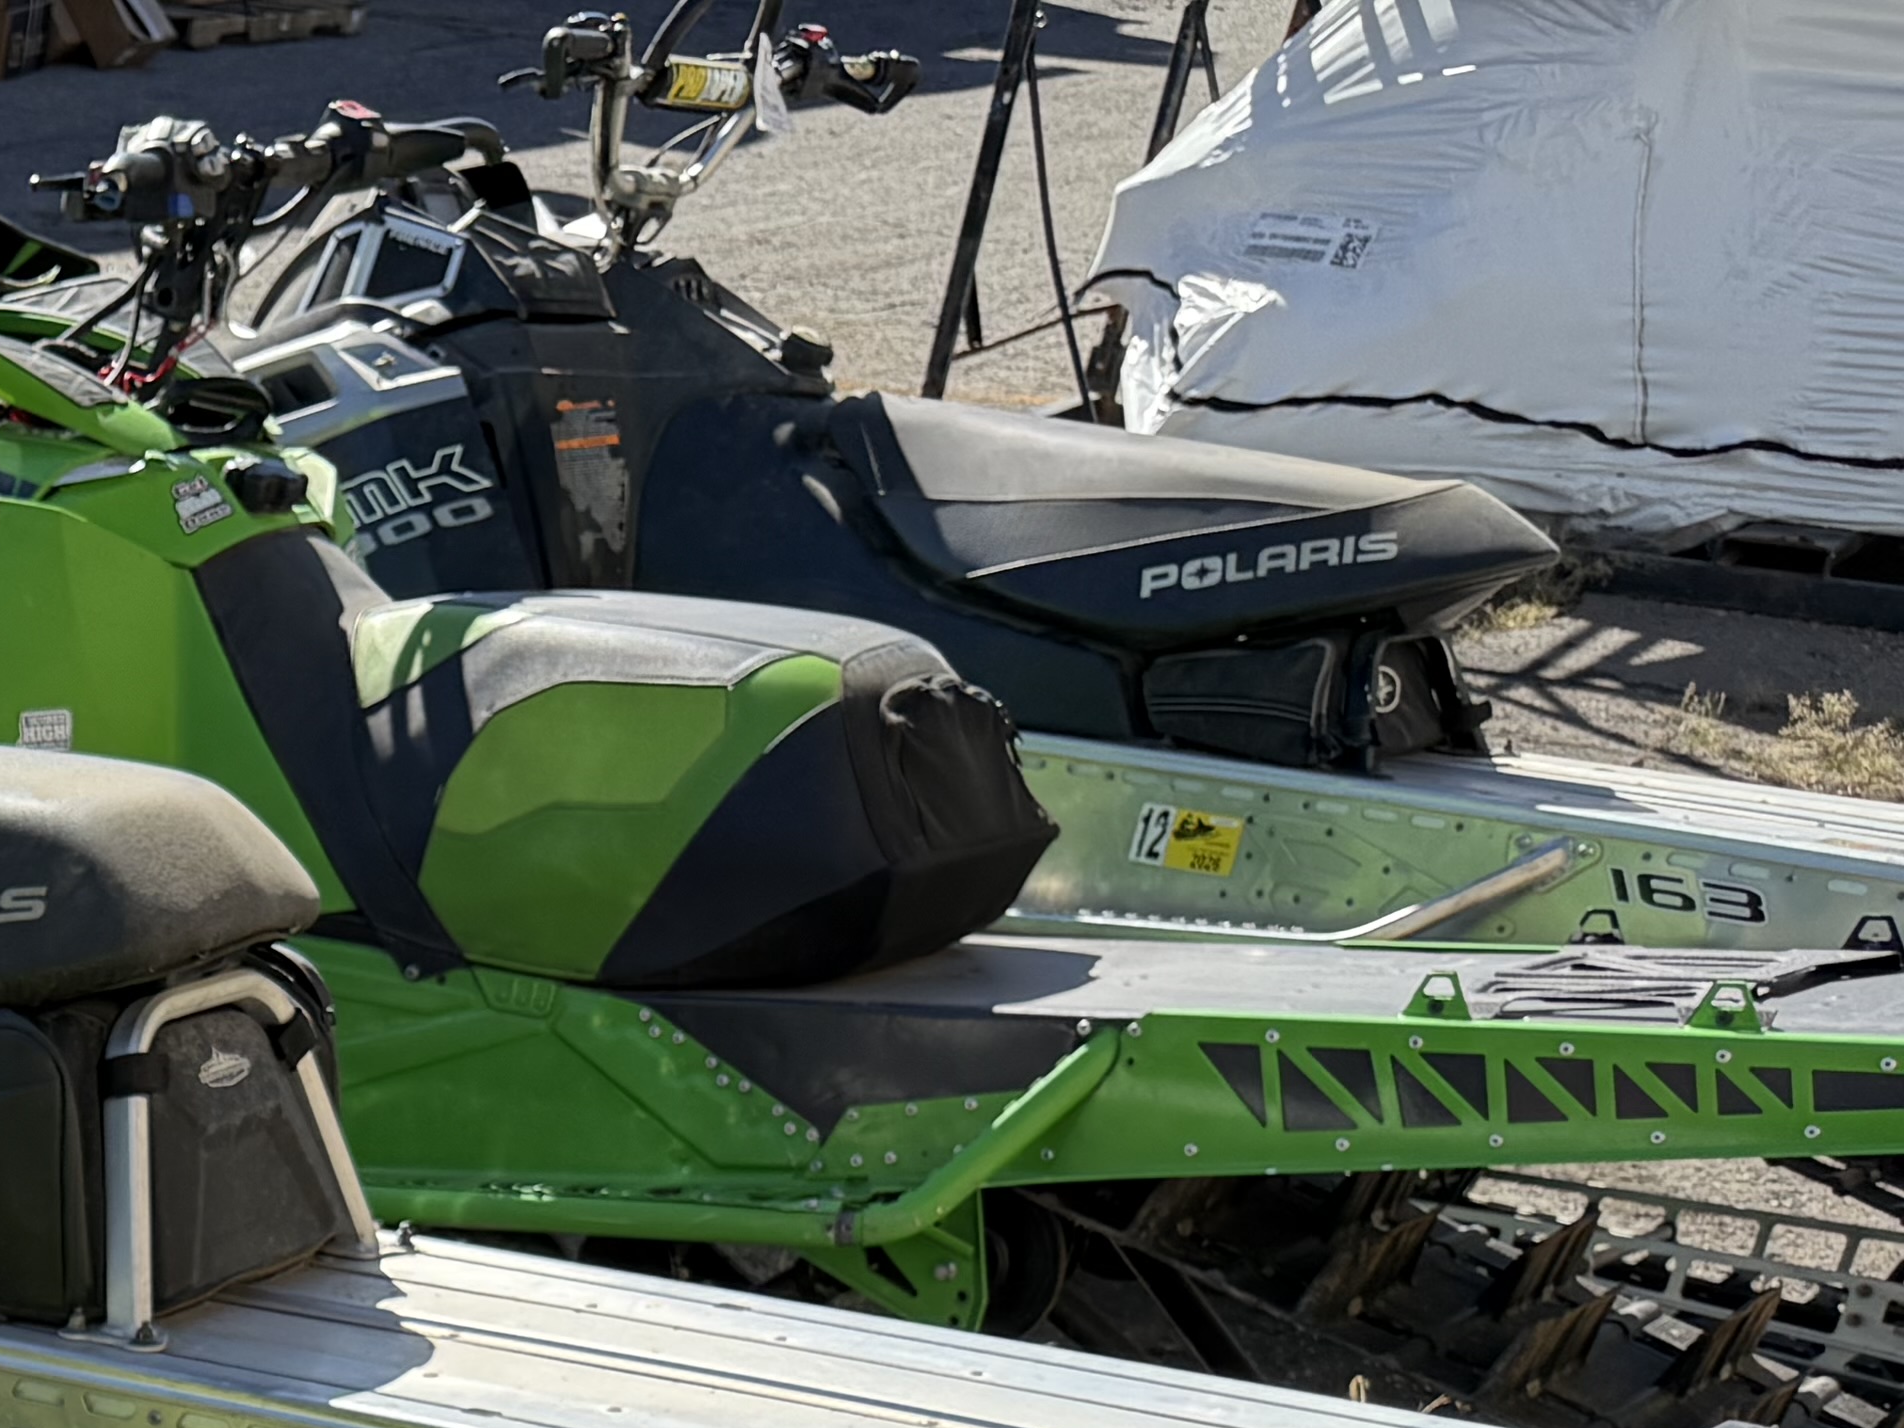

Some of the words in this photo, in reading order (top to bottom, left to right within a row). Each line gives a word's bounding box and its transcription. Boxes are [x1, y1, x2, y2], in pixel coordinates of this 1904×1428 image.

[340, 443, 493, 529] MK
[1139, 531, 1398, 599] POLARIS
[1136, 807, 1170, 860] 12
[1608, 866, 1769, 924] 163
